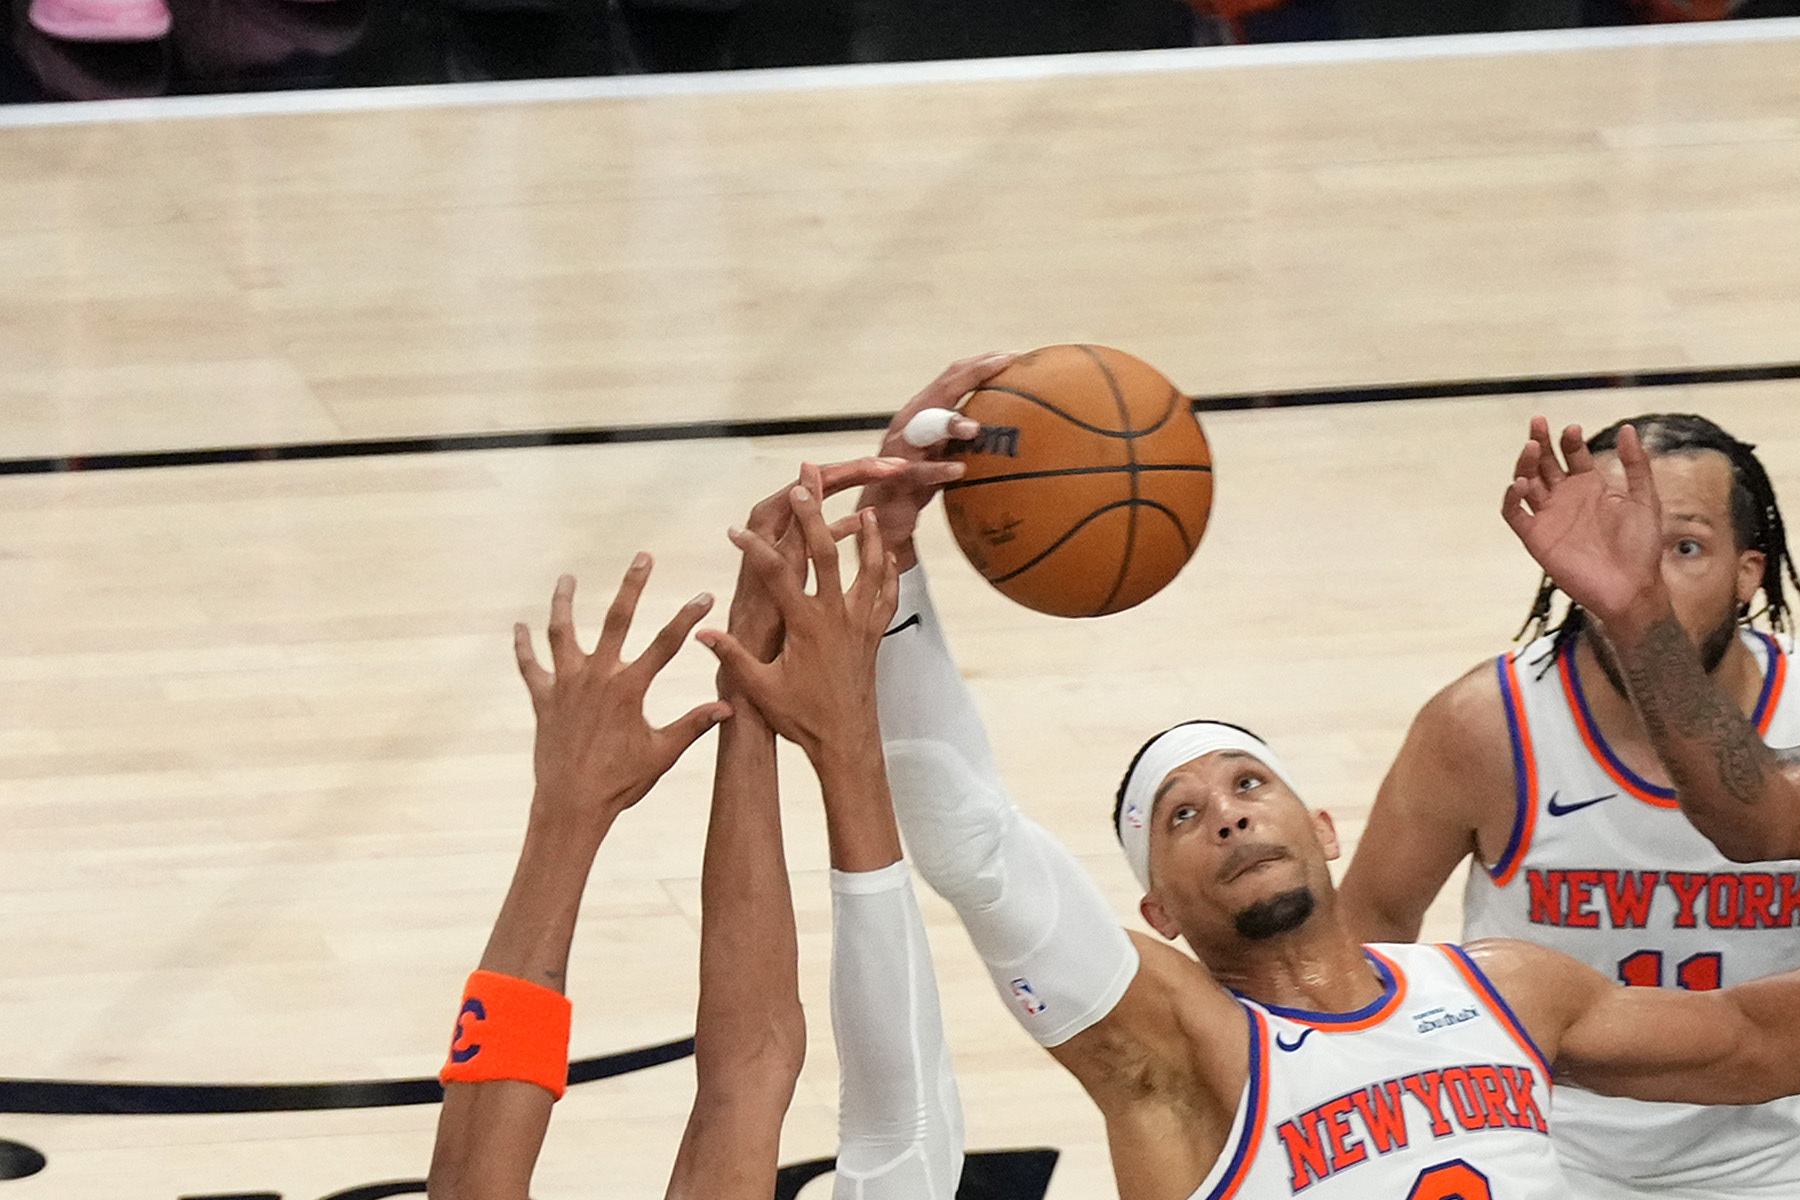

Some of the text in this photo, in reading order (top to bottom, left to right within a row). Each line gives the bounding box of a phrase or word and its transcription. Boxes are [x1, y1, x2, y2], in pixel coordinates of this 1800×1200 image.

[1525, 868, 1660, 930] NEW
[1276, 1063, 1550, 1197] NEW YORK
